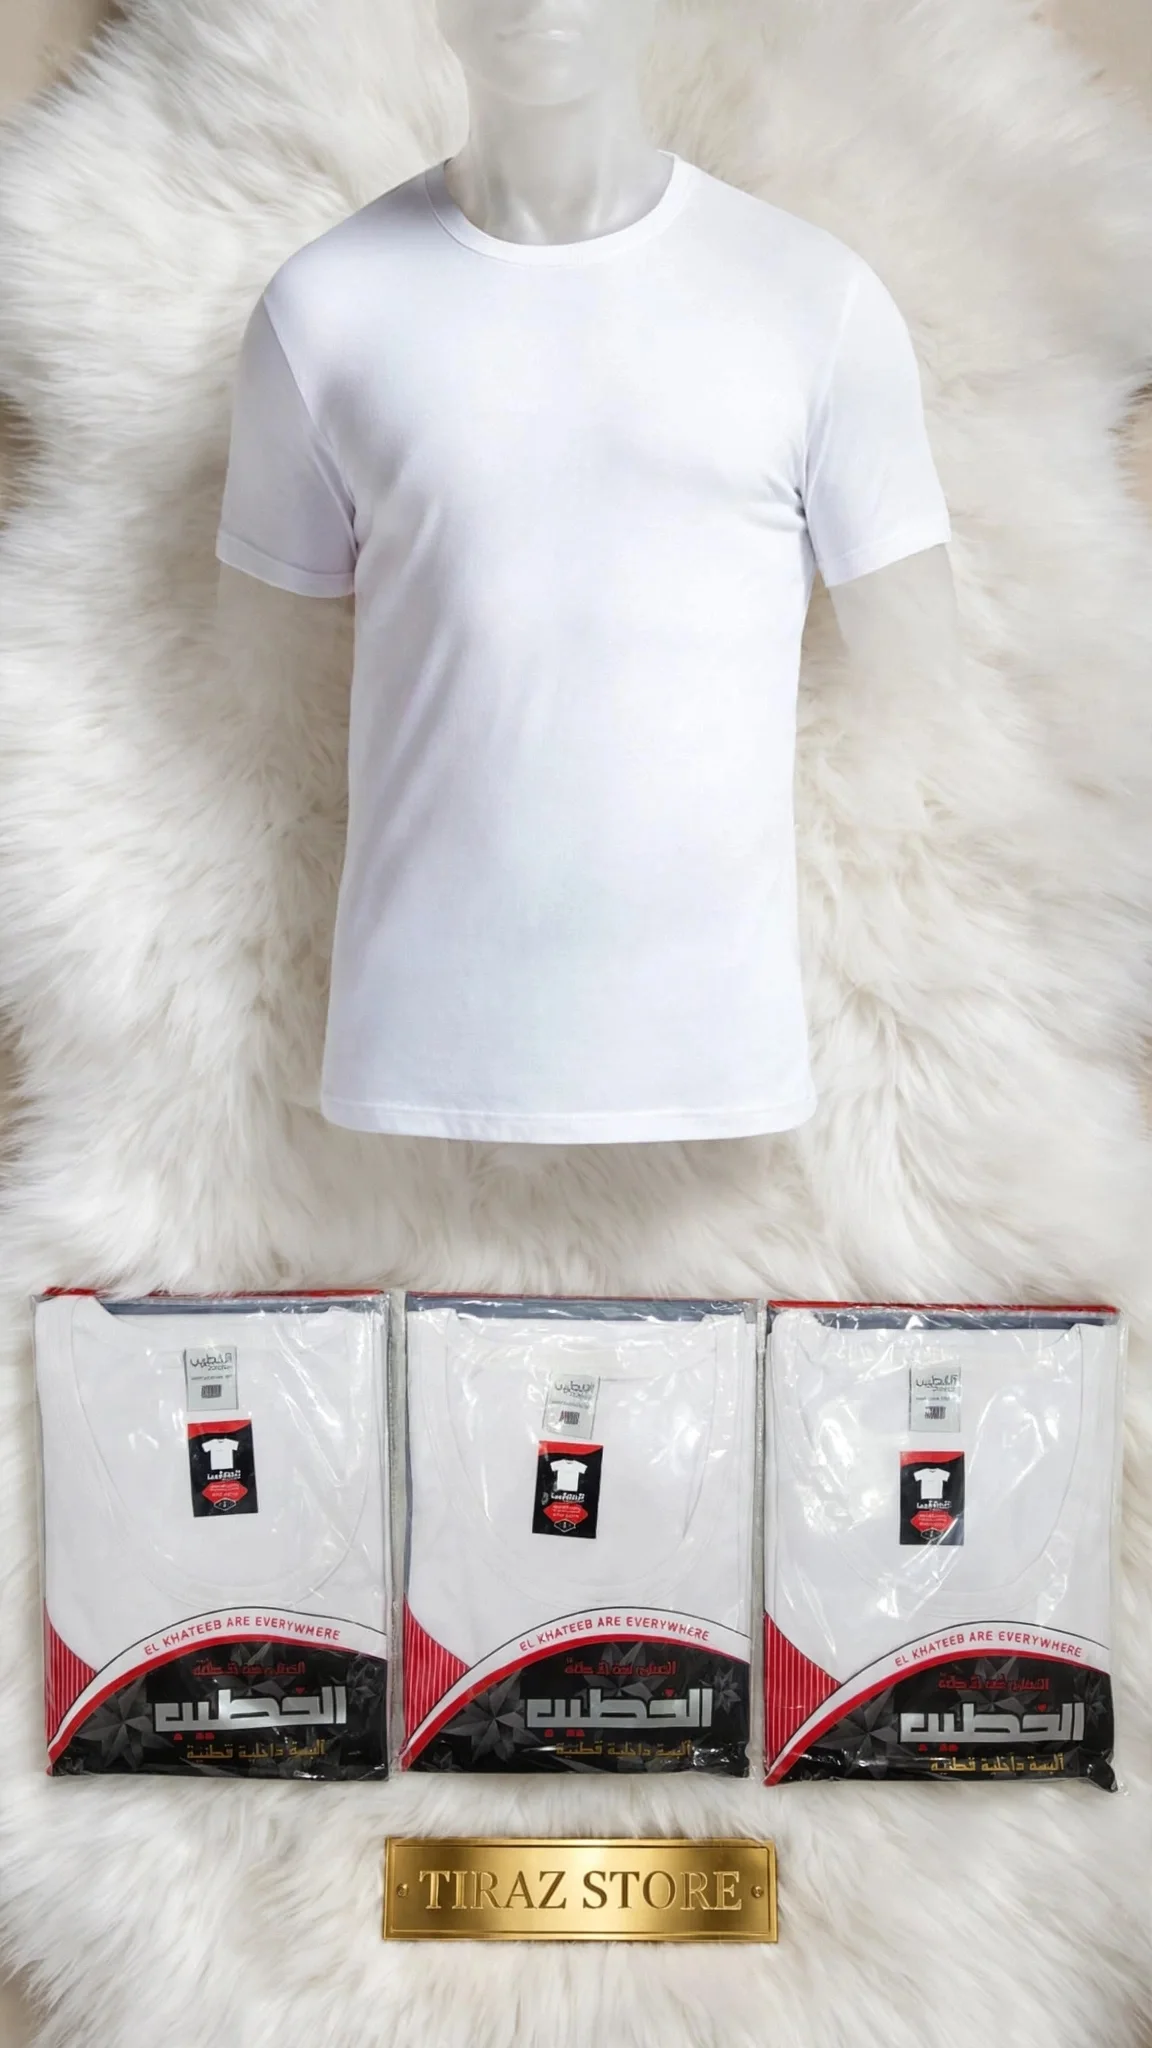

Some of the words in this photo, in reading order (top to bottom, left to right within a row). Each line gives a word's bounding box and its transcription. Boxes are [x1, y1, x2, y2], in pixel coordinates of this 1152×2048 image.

[144, 1644, 160, 1656] EL
[162, 1619, 223, 1648] KHATEEB
[226, 1616, 250, 1628] ARE
[255, 1616, 341, 1641] EVERYWHERE
[519, 1639, 536, 1652] EL
[537, 1618, 594, 1644] KHATEEB
[597, 1616, 621, 1628] ARE
[626, 1616, 710, 1642] EVERYWHERE
[894, 1655, 909, 1668] EL
[912, 1633, 966, 1659] KHATEEB
[969, 1630, 993, 1642] ARE
[998, 1631, 1083, 1658] EVERYWHERE
[155, 1686, 347, 1741] الخطيب
[527, 1688, 714, 1737] الخطيب
[900, 1702, 1085, 1752] الخطيب
[186, 1743, 234, 1763] قطنية
[419, 1869, 567, 1911] TIRAZ
[582, 1869, 743, 1911] STORE
